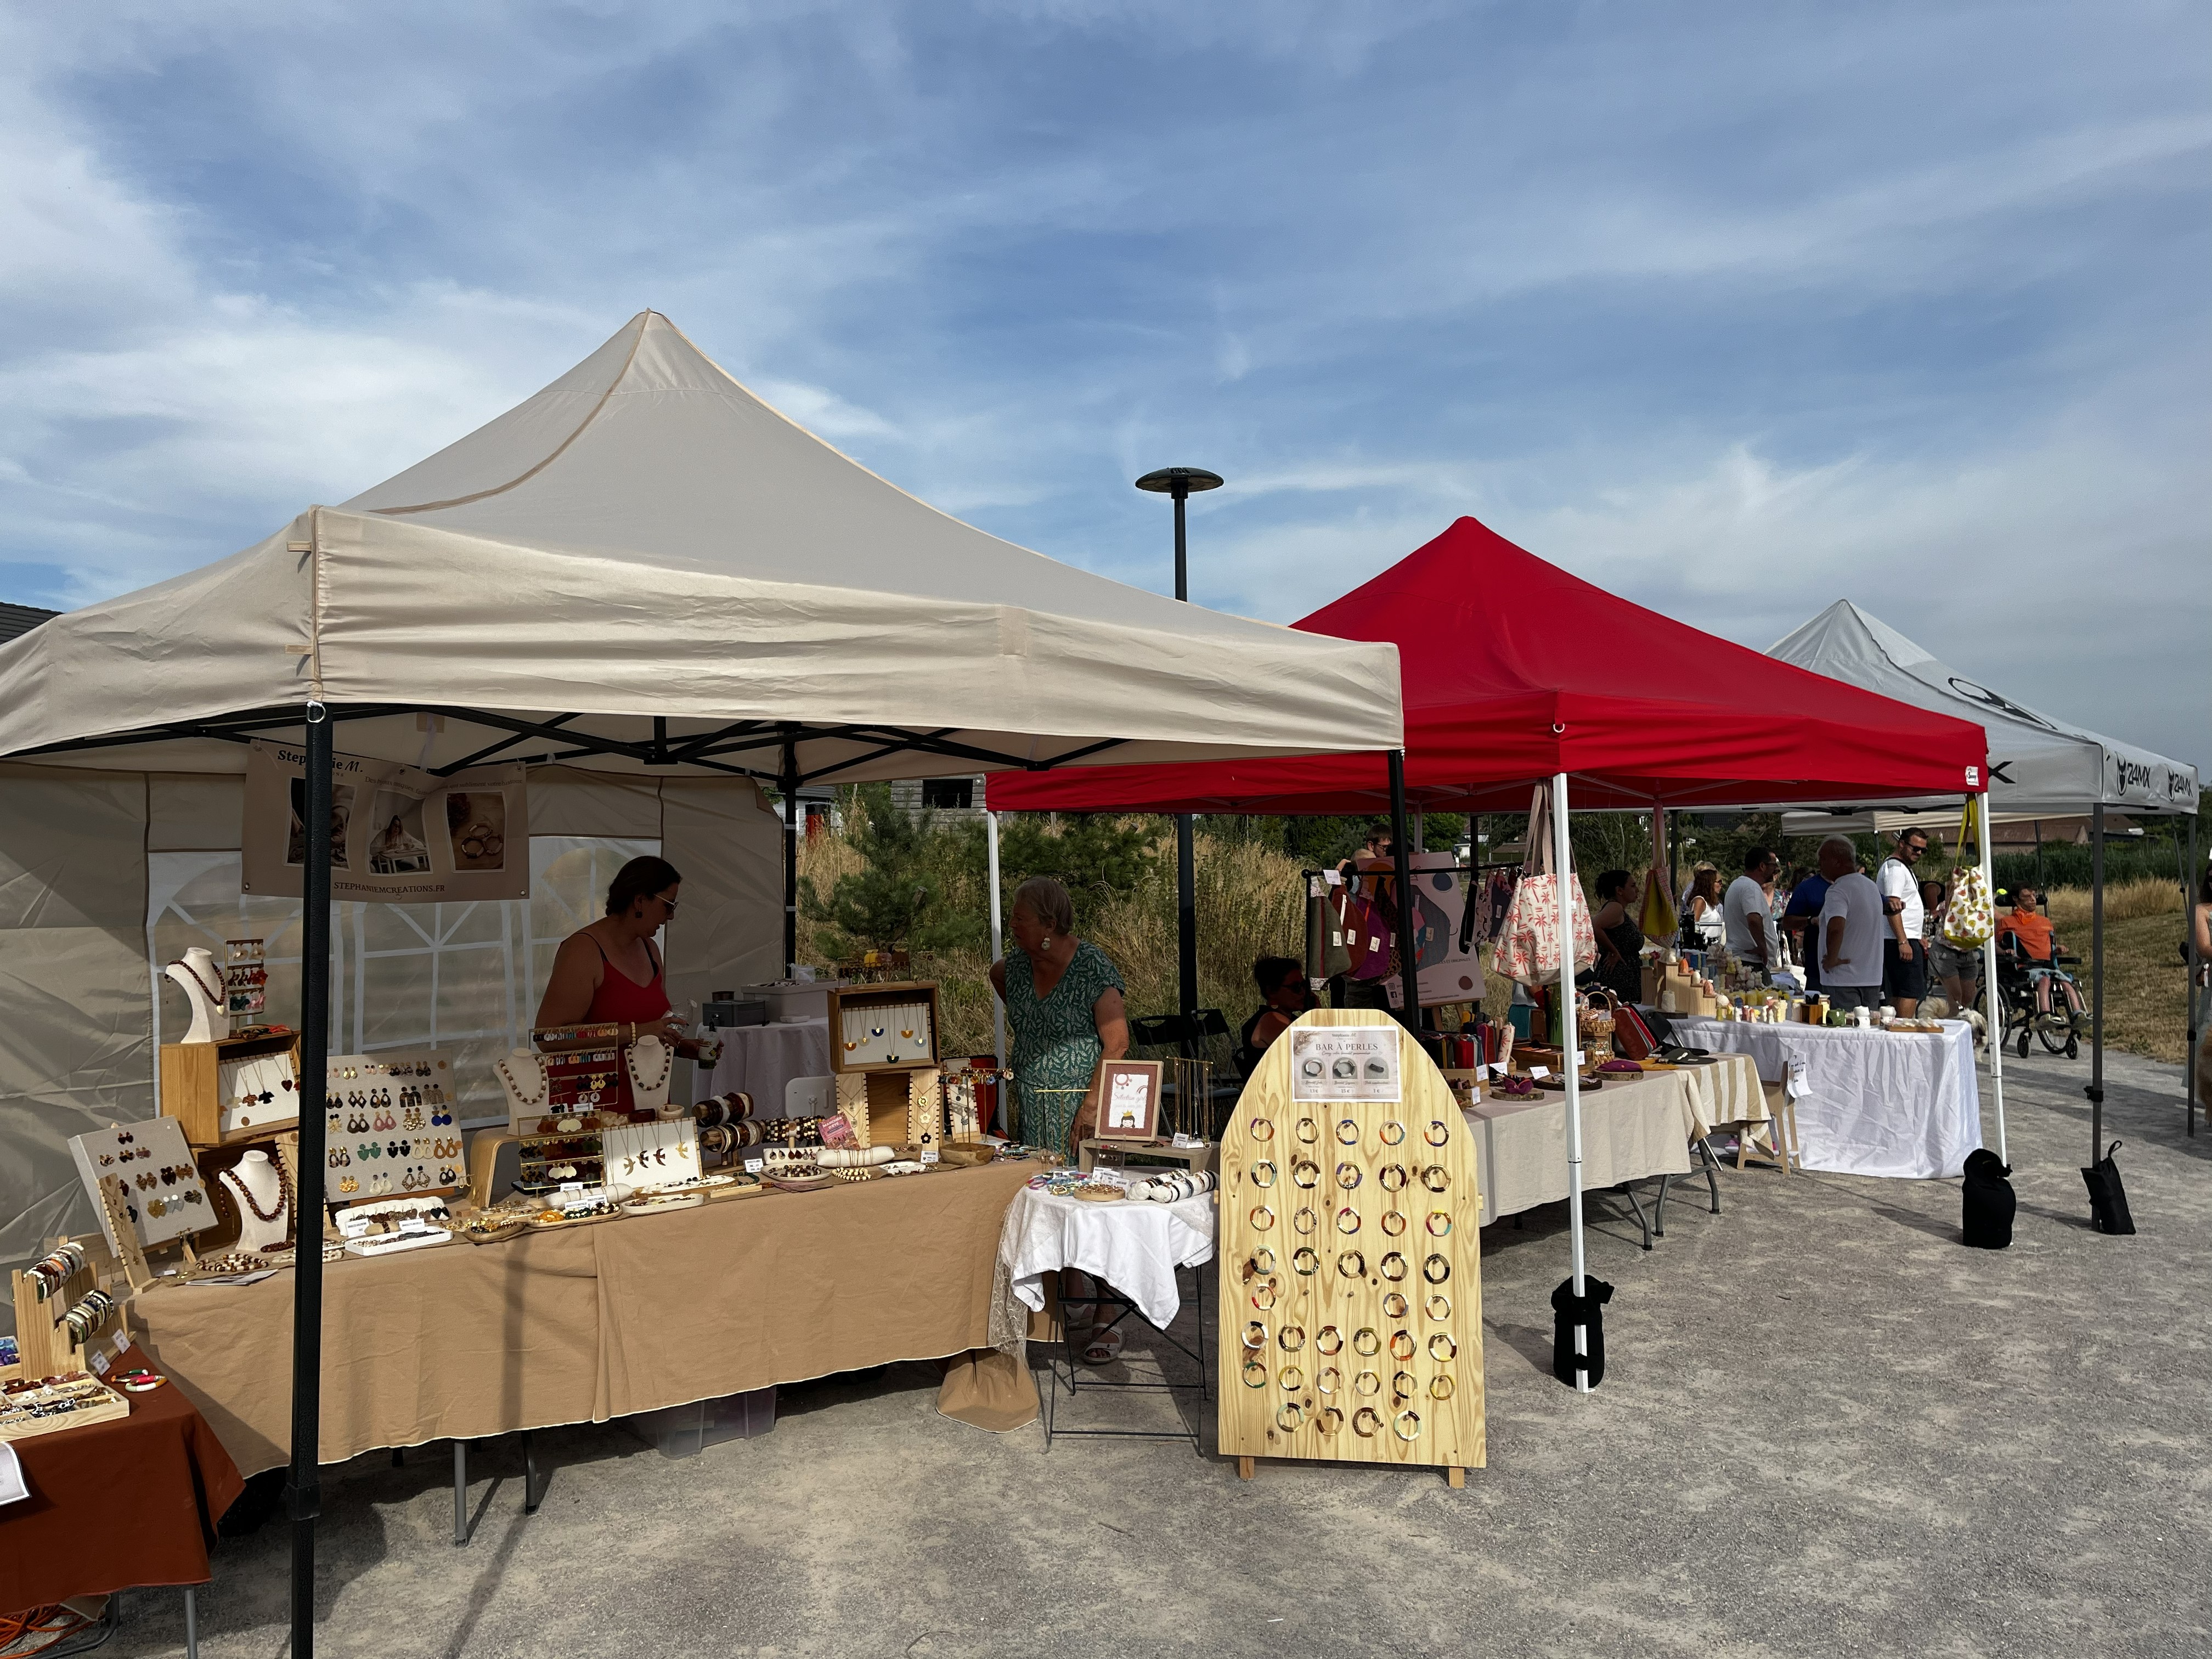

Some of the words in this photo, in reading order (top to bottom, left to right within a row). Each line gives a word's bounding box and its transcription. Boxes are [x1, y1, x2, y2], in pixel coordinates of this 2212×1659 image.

[278, 750, 343, 769] Stepie
[345, 760, 363, 772] M.
[2127, 763, 2151, 788] 24MX
[2174, 773, 2193, 798] 24MX
[334, 882, 445, 894] STEPHANIEMCREATIONS.FR
[1336, 1042, 1342, 1051] À
